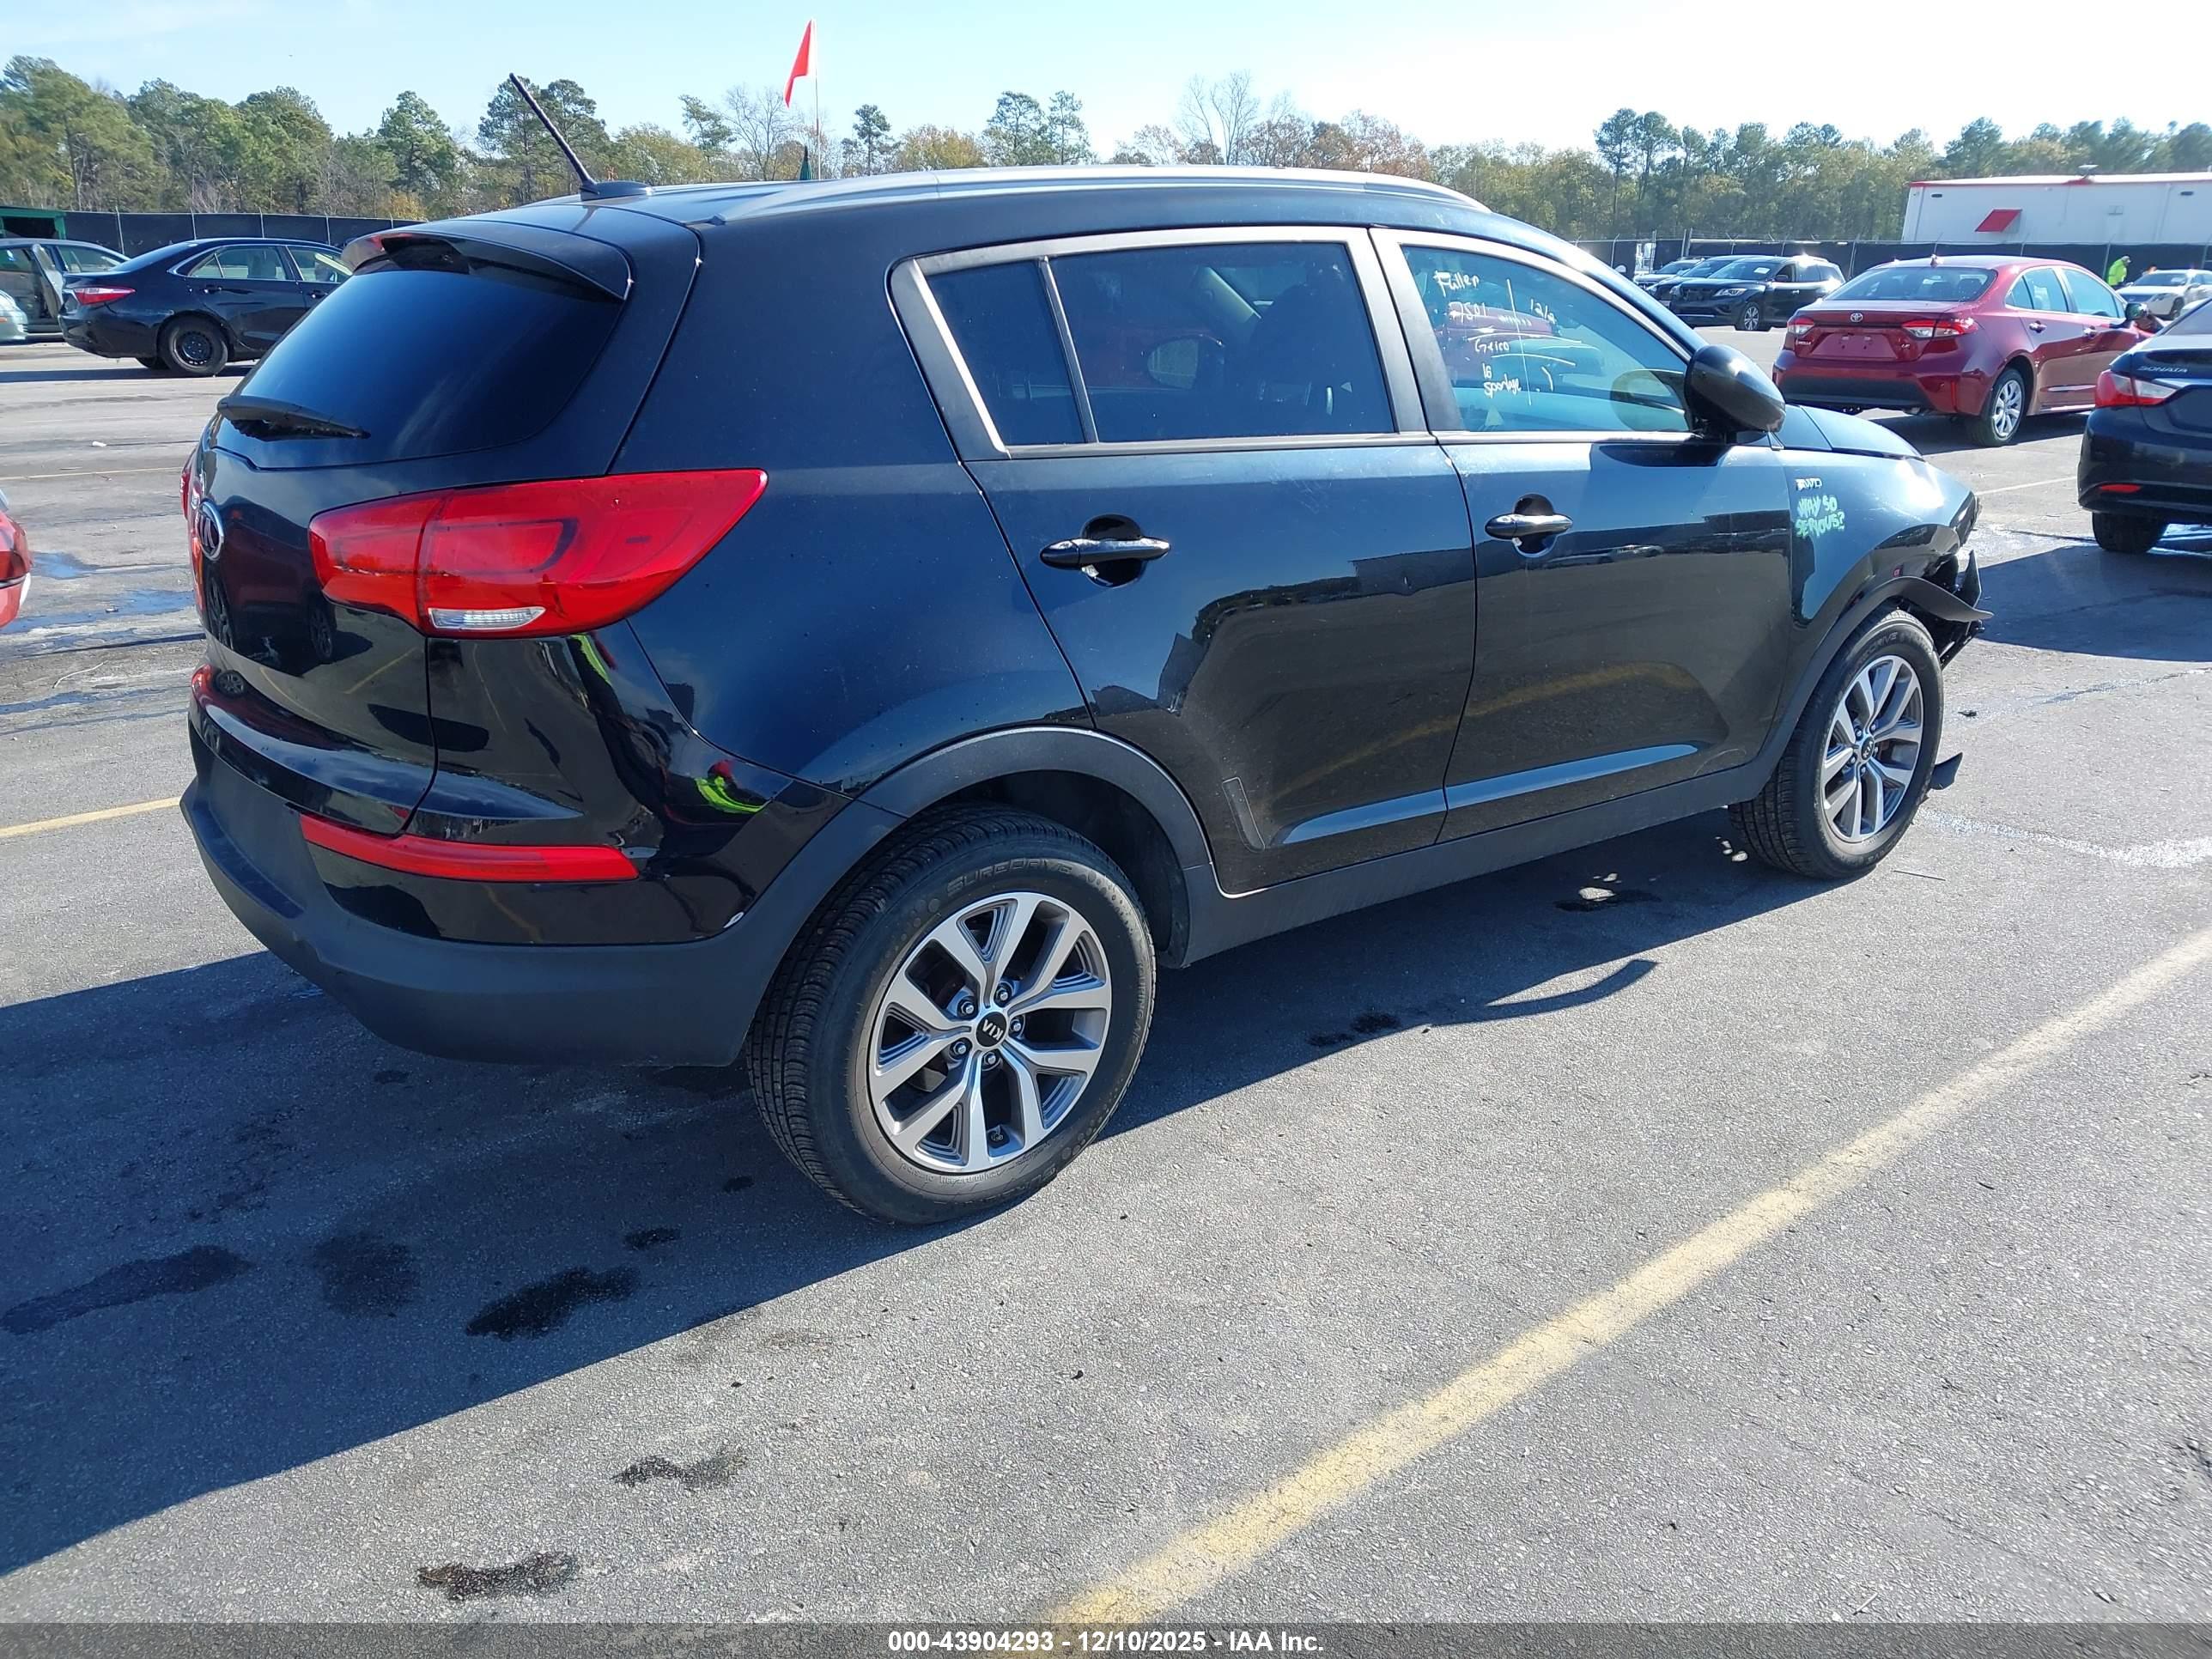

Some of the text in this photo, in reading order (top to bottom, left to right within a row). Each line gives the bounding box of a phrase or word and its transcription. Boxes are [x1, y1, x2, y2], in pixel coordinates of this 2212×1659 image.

[1482, 362, 1492, 379] 16
[1822, 495, 1838, 512] SO
[1795, 511, 1844, 538] SERIOUS?
[982, 1018, 1004, 1041] KIA
